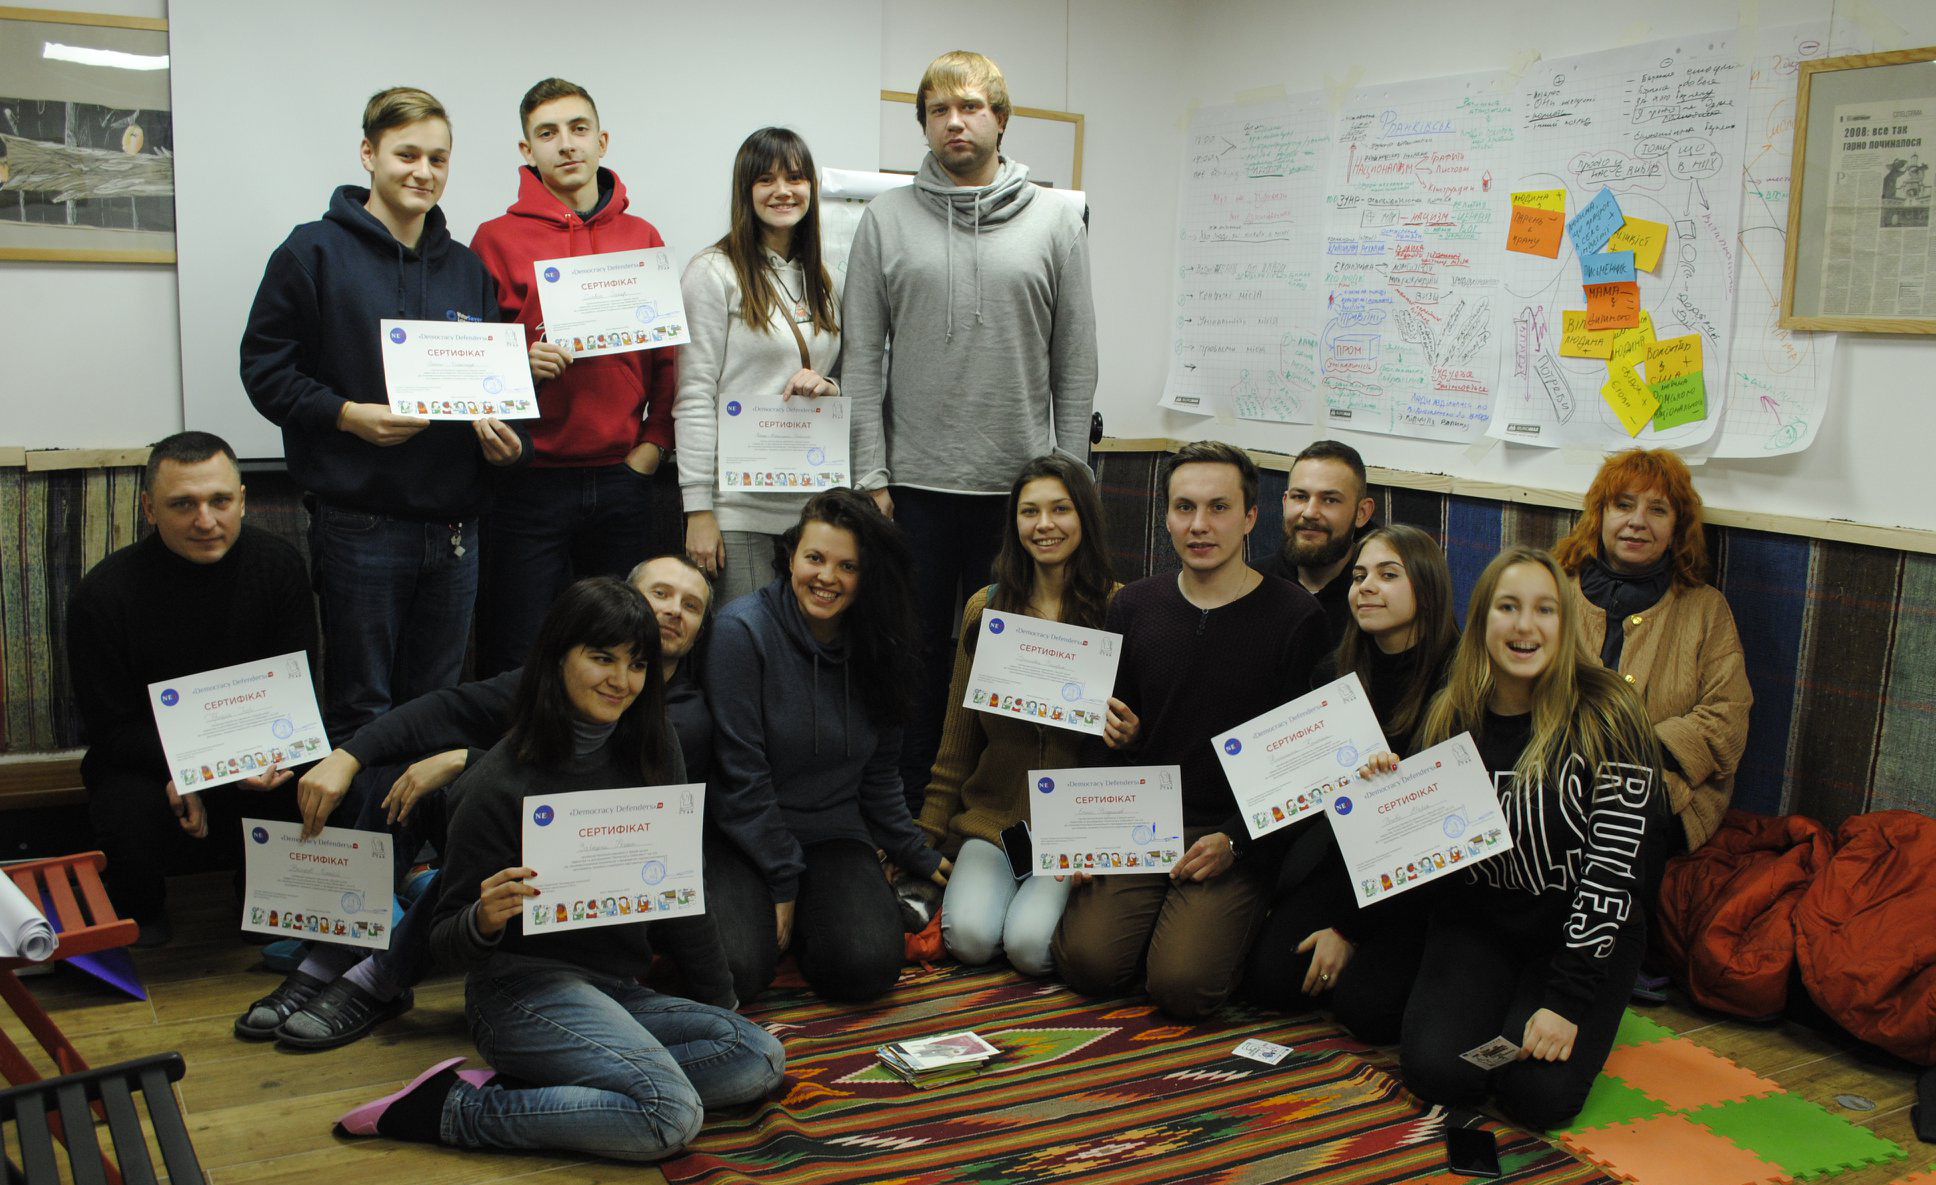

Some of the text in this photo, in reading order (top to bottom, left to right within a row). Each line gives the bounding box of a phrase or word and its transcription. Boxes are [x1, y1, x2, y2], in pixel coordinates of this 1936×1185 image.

[1844, 125, 1908, 138] 2008: все так
[1843, 138, 1922, 151] гарно починалося
[581, 277, 638, 291] СЕРТИФІКАТ
[428, 349, 486, 357] СЕРТИФІКАТ
[758, 420, 812, 429] СЕРТИФІКАТ
[1019, 643, 1077, 661] СЕРТИФІКАТ
[204, 690, 268, 711] СЕРТИФІКАТ
[1266, 720, 1325, 753] СЕРТИФІКАТ
[1075, 795, 1137, 804] СЕРТИФІКАТ
[1377, 782, 1439, 815] СЕРТИФІКАТ
[578, 822, 651, 838] СЕРТИФІКАТ
[289, 852, 350, 867] СЕРТИФІКАТ
